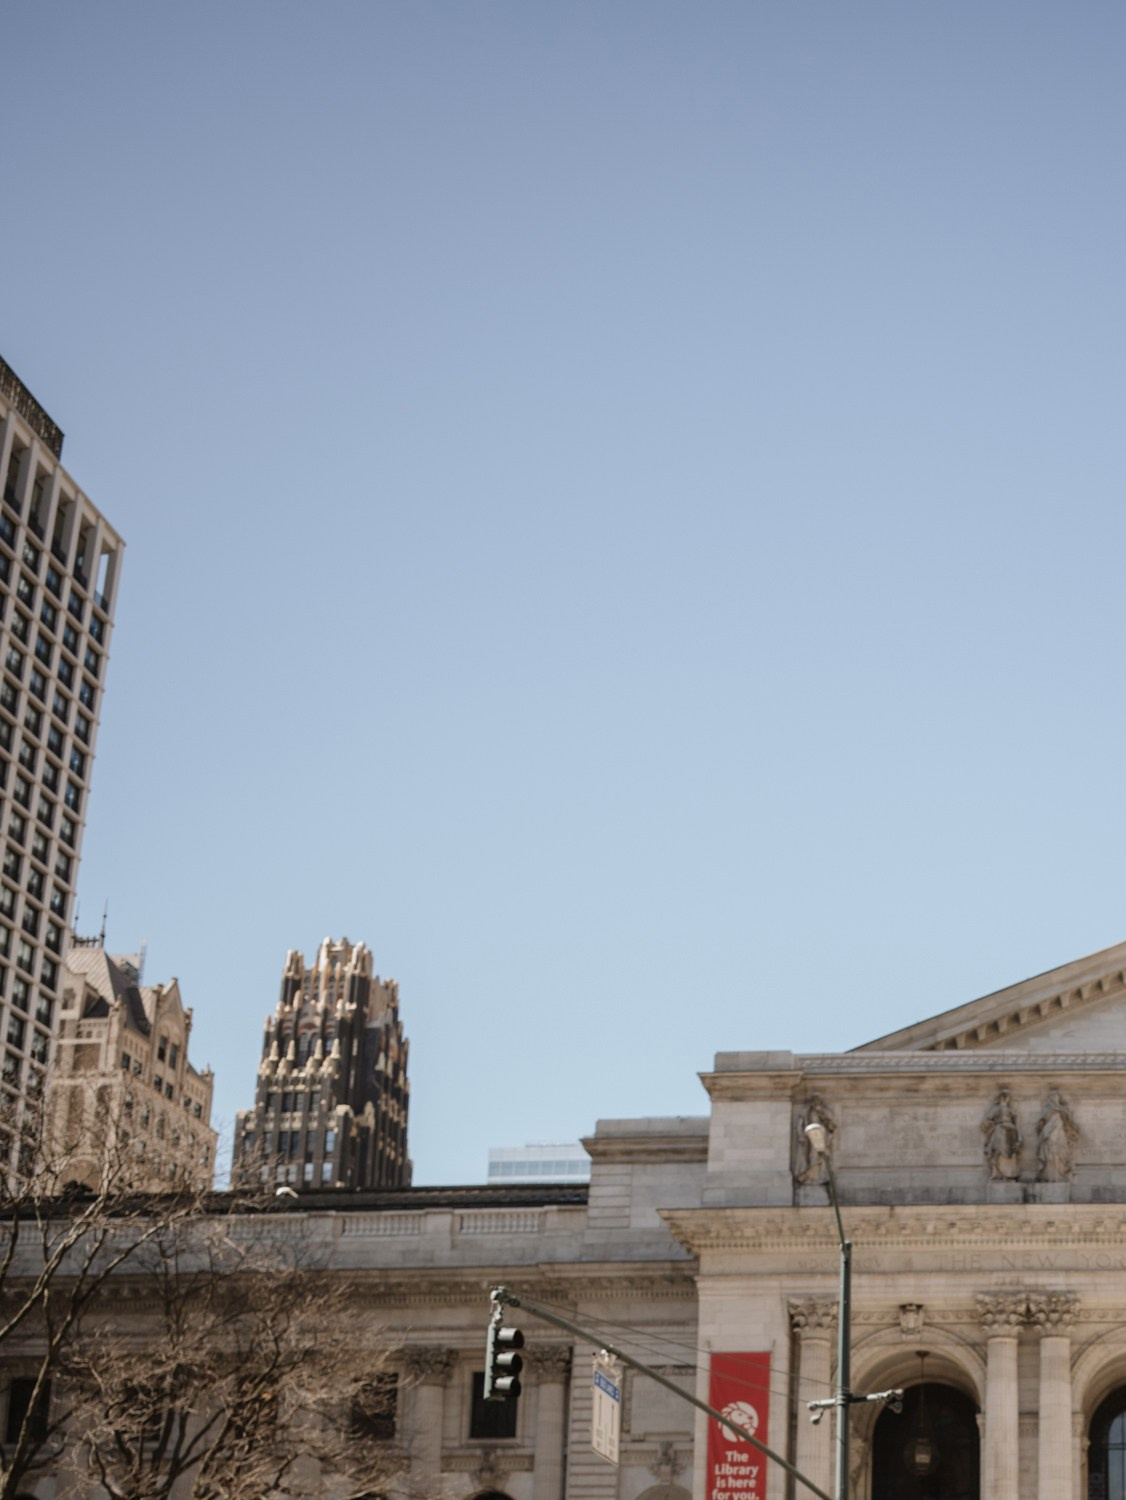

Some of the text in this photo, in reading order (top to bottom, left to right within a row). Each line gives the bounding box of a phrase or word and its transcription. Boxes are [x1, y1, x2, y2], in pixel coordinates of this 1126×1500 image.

[934, 1253, 983, 1270] THE
[1001, 1253, 1060, 1270] NEW
[725, 1450, 749, 1463] The
[715, 1463, 759, 1478] Library
[716, 1476, 756, 1489] is here
[712, 1488, 731, 1500] for
